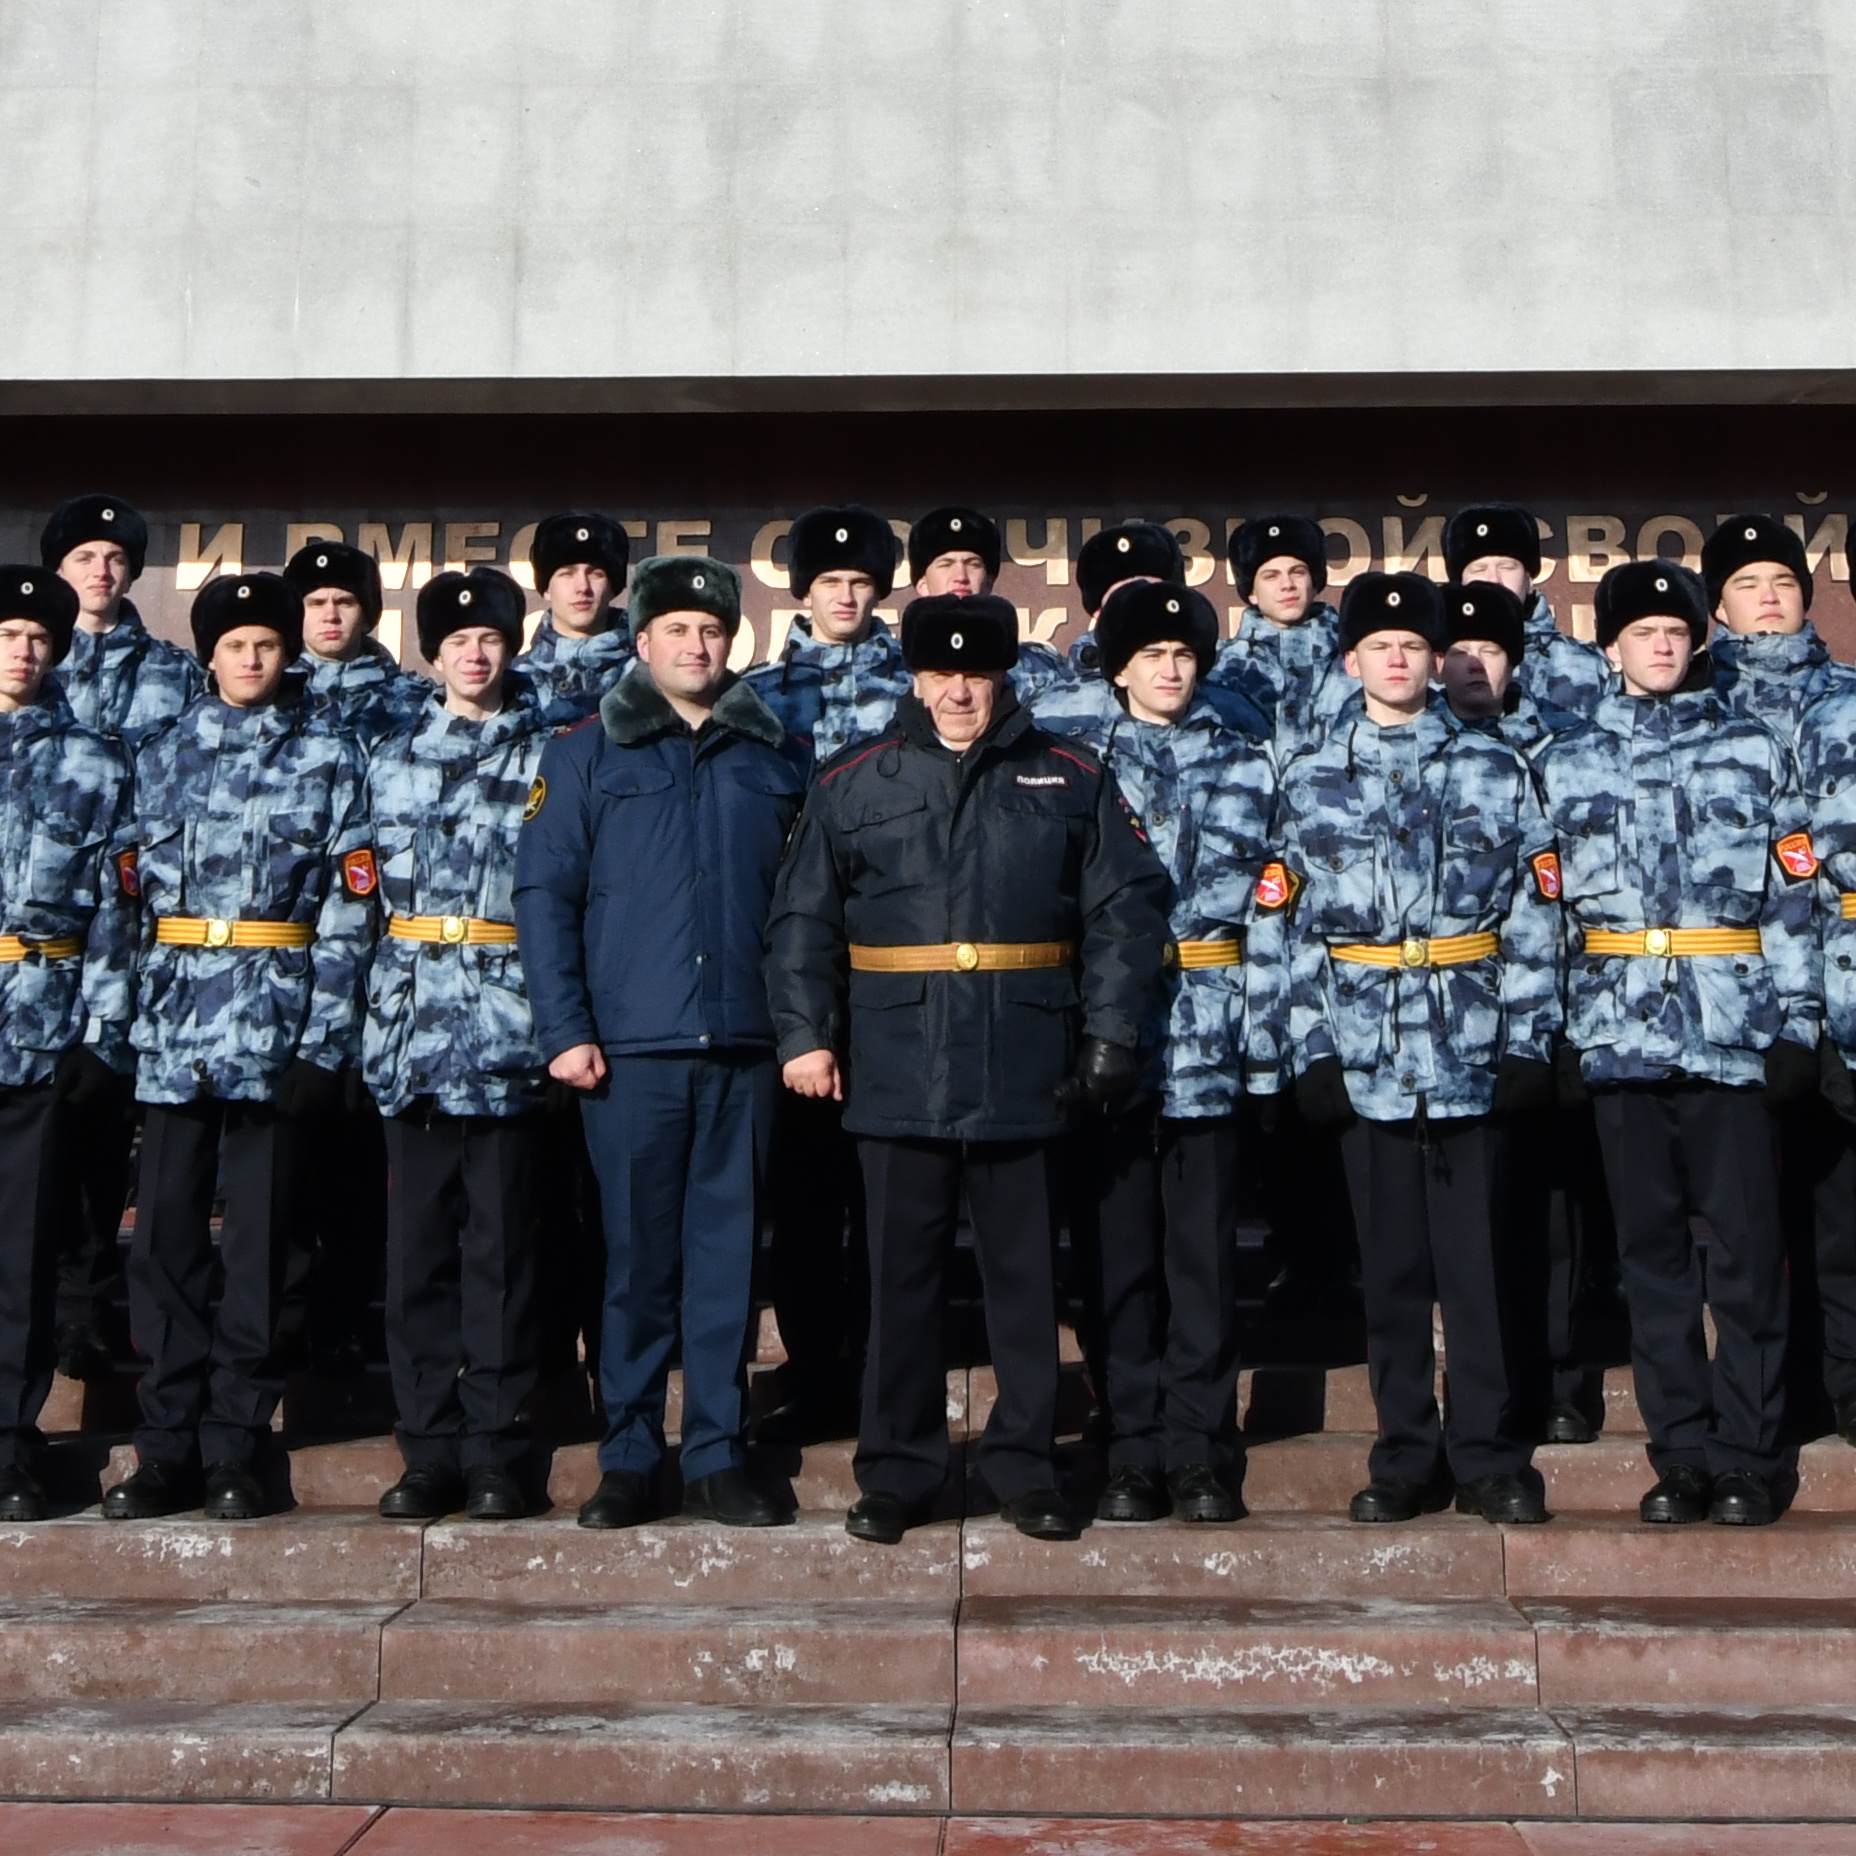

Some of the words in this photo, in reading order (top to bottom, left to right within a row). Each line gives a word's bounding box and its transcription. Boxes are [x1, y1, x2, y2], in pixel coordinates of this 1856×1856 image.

[176, 522, 244, 590] И
[286, 520, 712, 590] МЕСЕ
[889, 492, 1448, 588] ЧЗОЙ
[1531, 489, 1850, 585] ВОЙ
